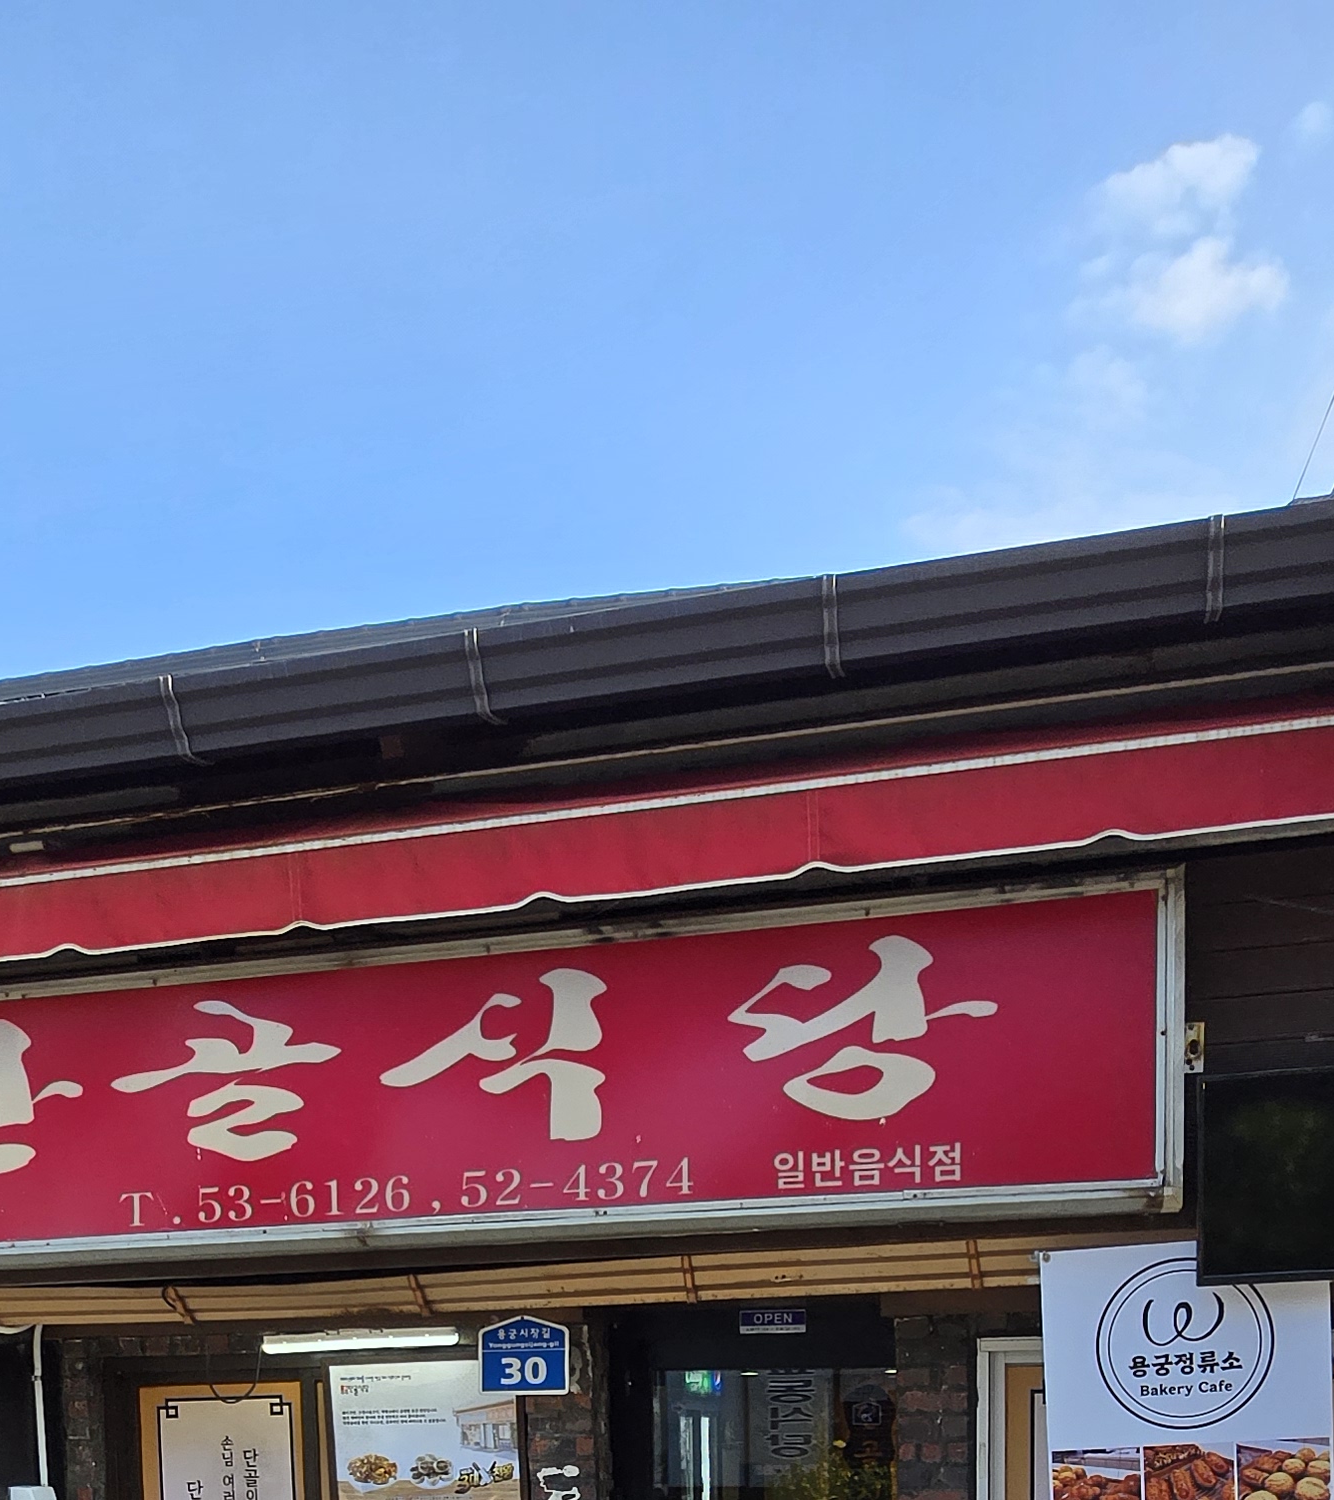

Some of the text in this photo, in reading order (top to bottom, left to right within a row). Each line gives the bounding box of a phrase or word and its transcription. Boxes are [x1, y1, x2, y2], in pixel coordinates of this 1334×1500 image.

[771, 1139, 963, 1192] 일반음식점
[754, 1313, 792, 1324] OPEN
[497, 1328, 550, 1340] 용궁시장길
[500, 1357, 547, 1385] 30
[1129, 1352, 1243, 1377] 용궁정류소
[1140, 1379, 1233, 1398] Bakery Cafe
[221, 1435, 234, 1467] 손님
